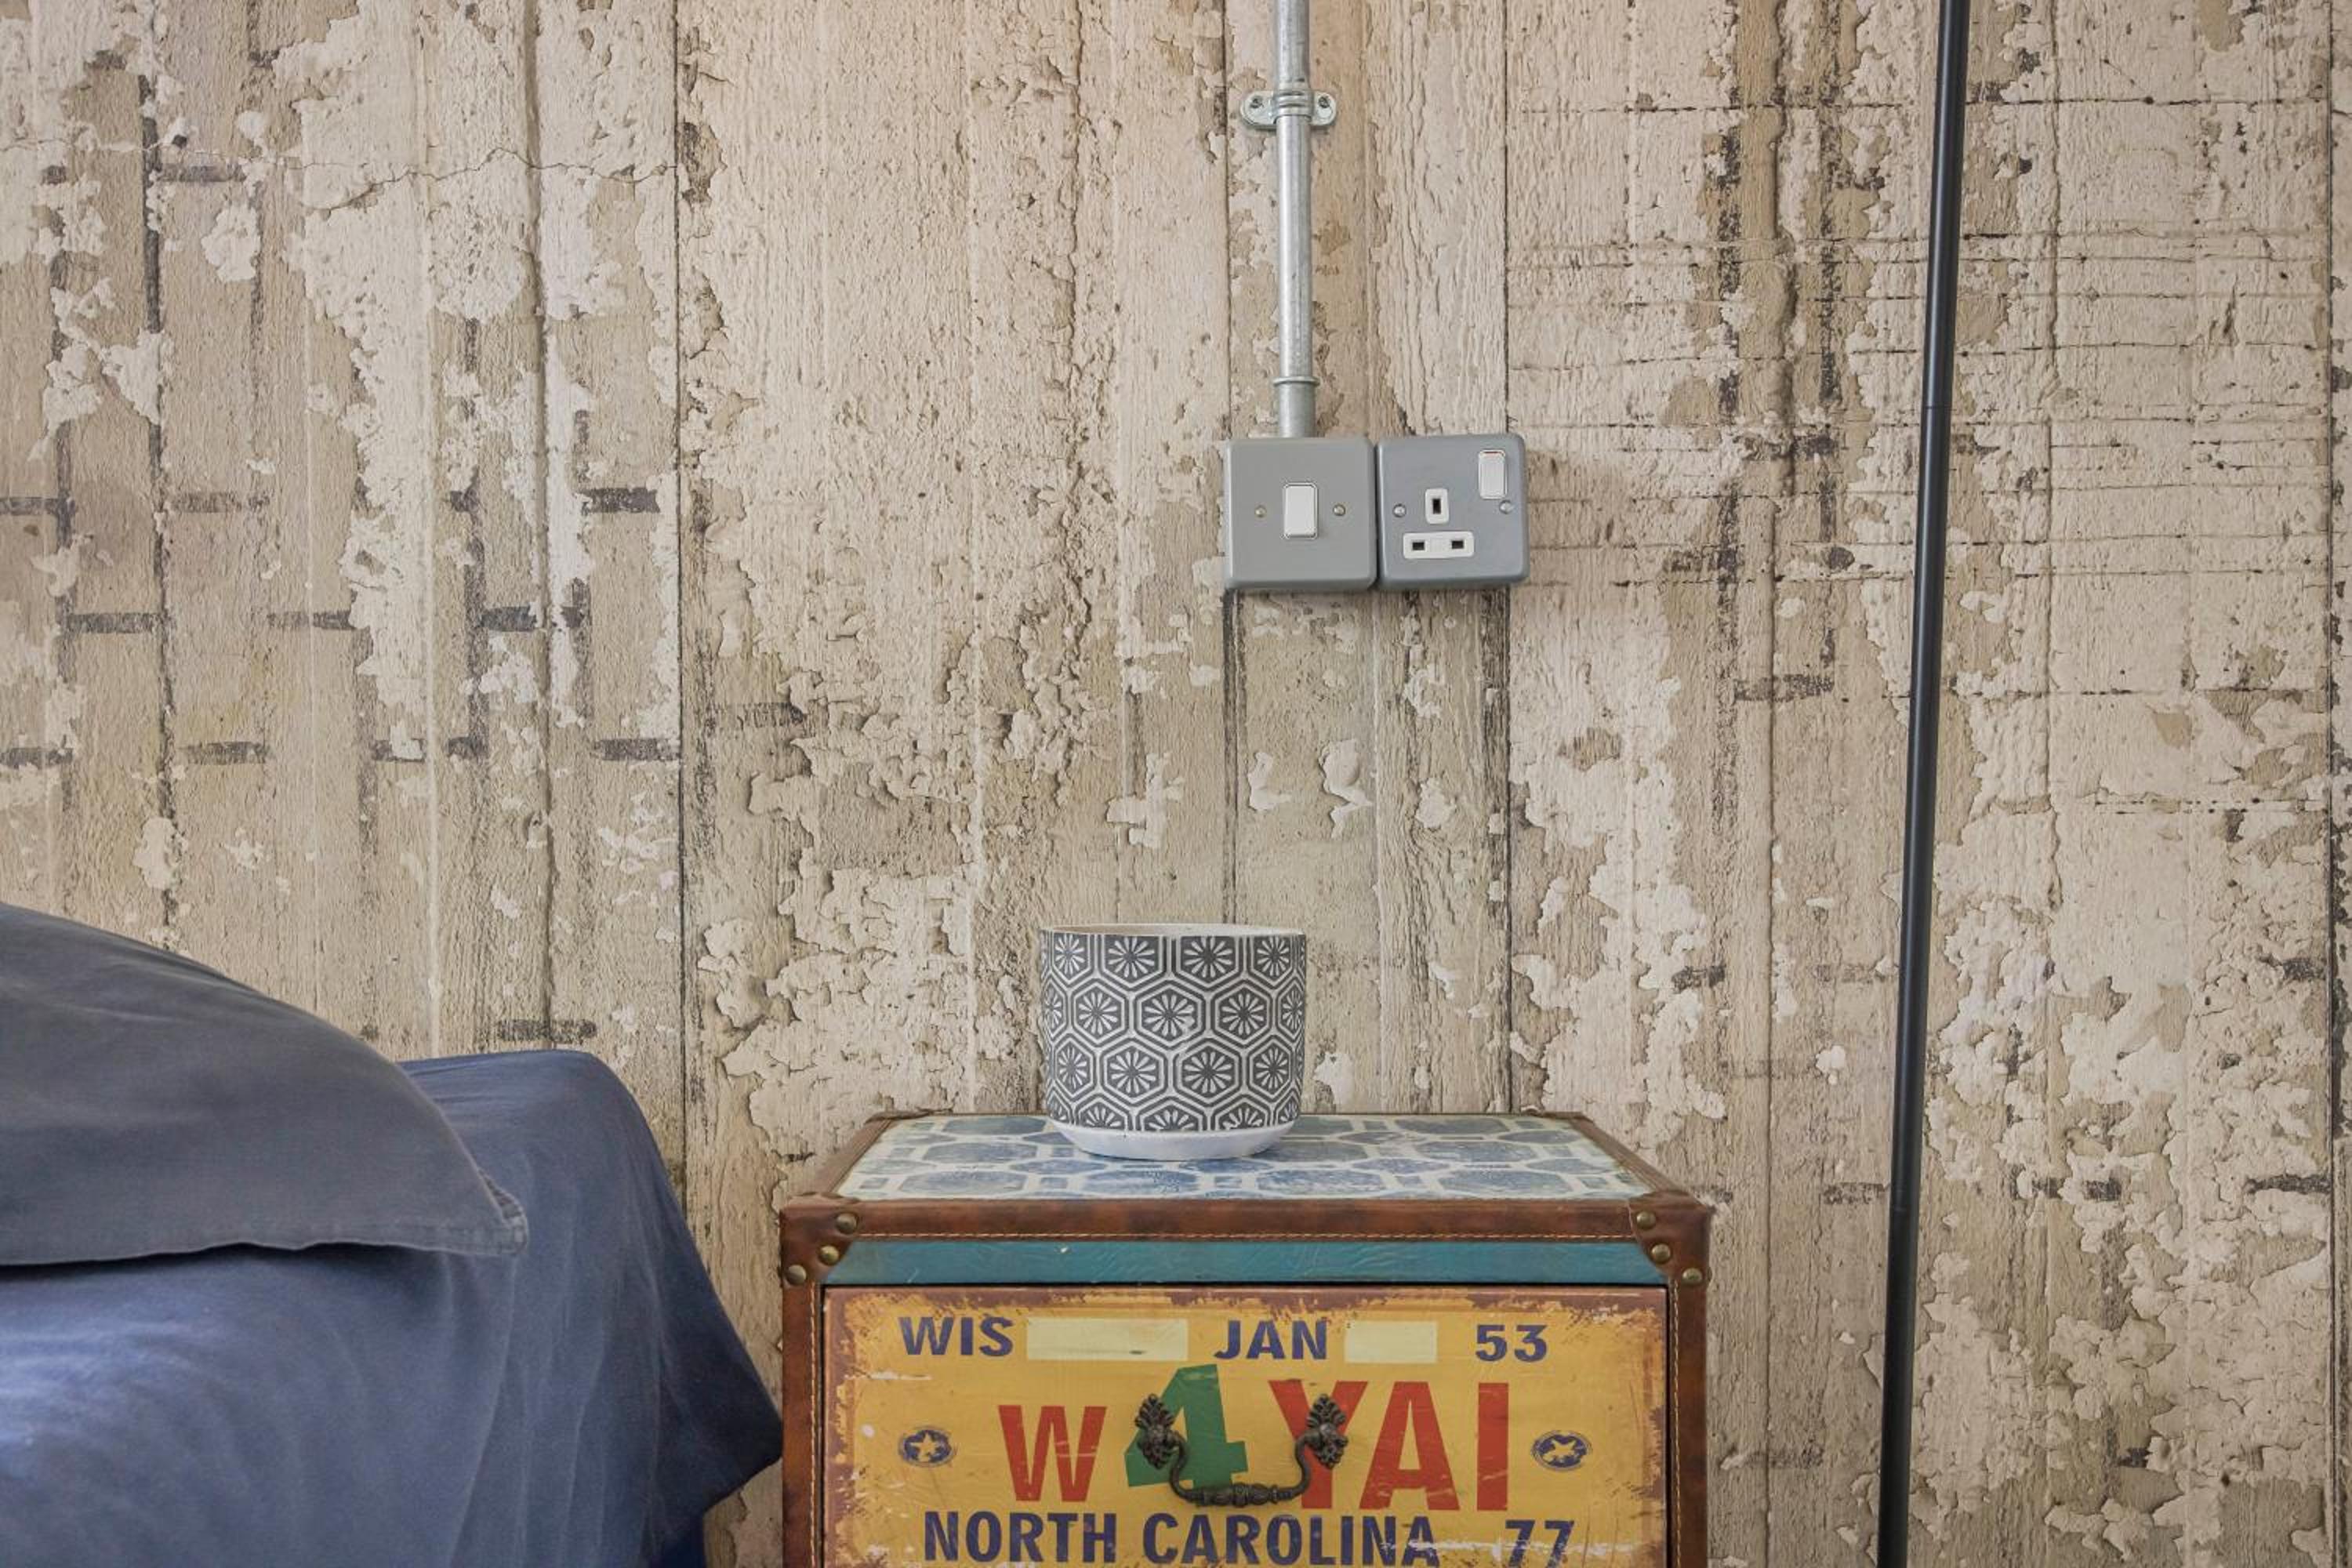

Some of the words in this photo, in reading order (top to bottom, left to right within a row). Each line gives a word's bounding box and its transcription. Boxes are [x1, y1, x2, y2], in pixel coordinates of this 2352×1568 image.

[899, 1316, 1014, 1357] WIS
[1214, 1319, 1327, 1360] JAN
[1475, 1323, 1548, 1362] 53
[925, 1511, 1117, 1563] NORTH
[1143, 1513, 1439, 1566] CAROLINA
[1505, 1519, 1575, 1568] 77
